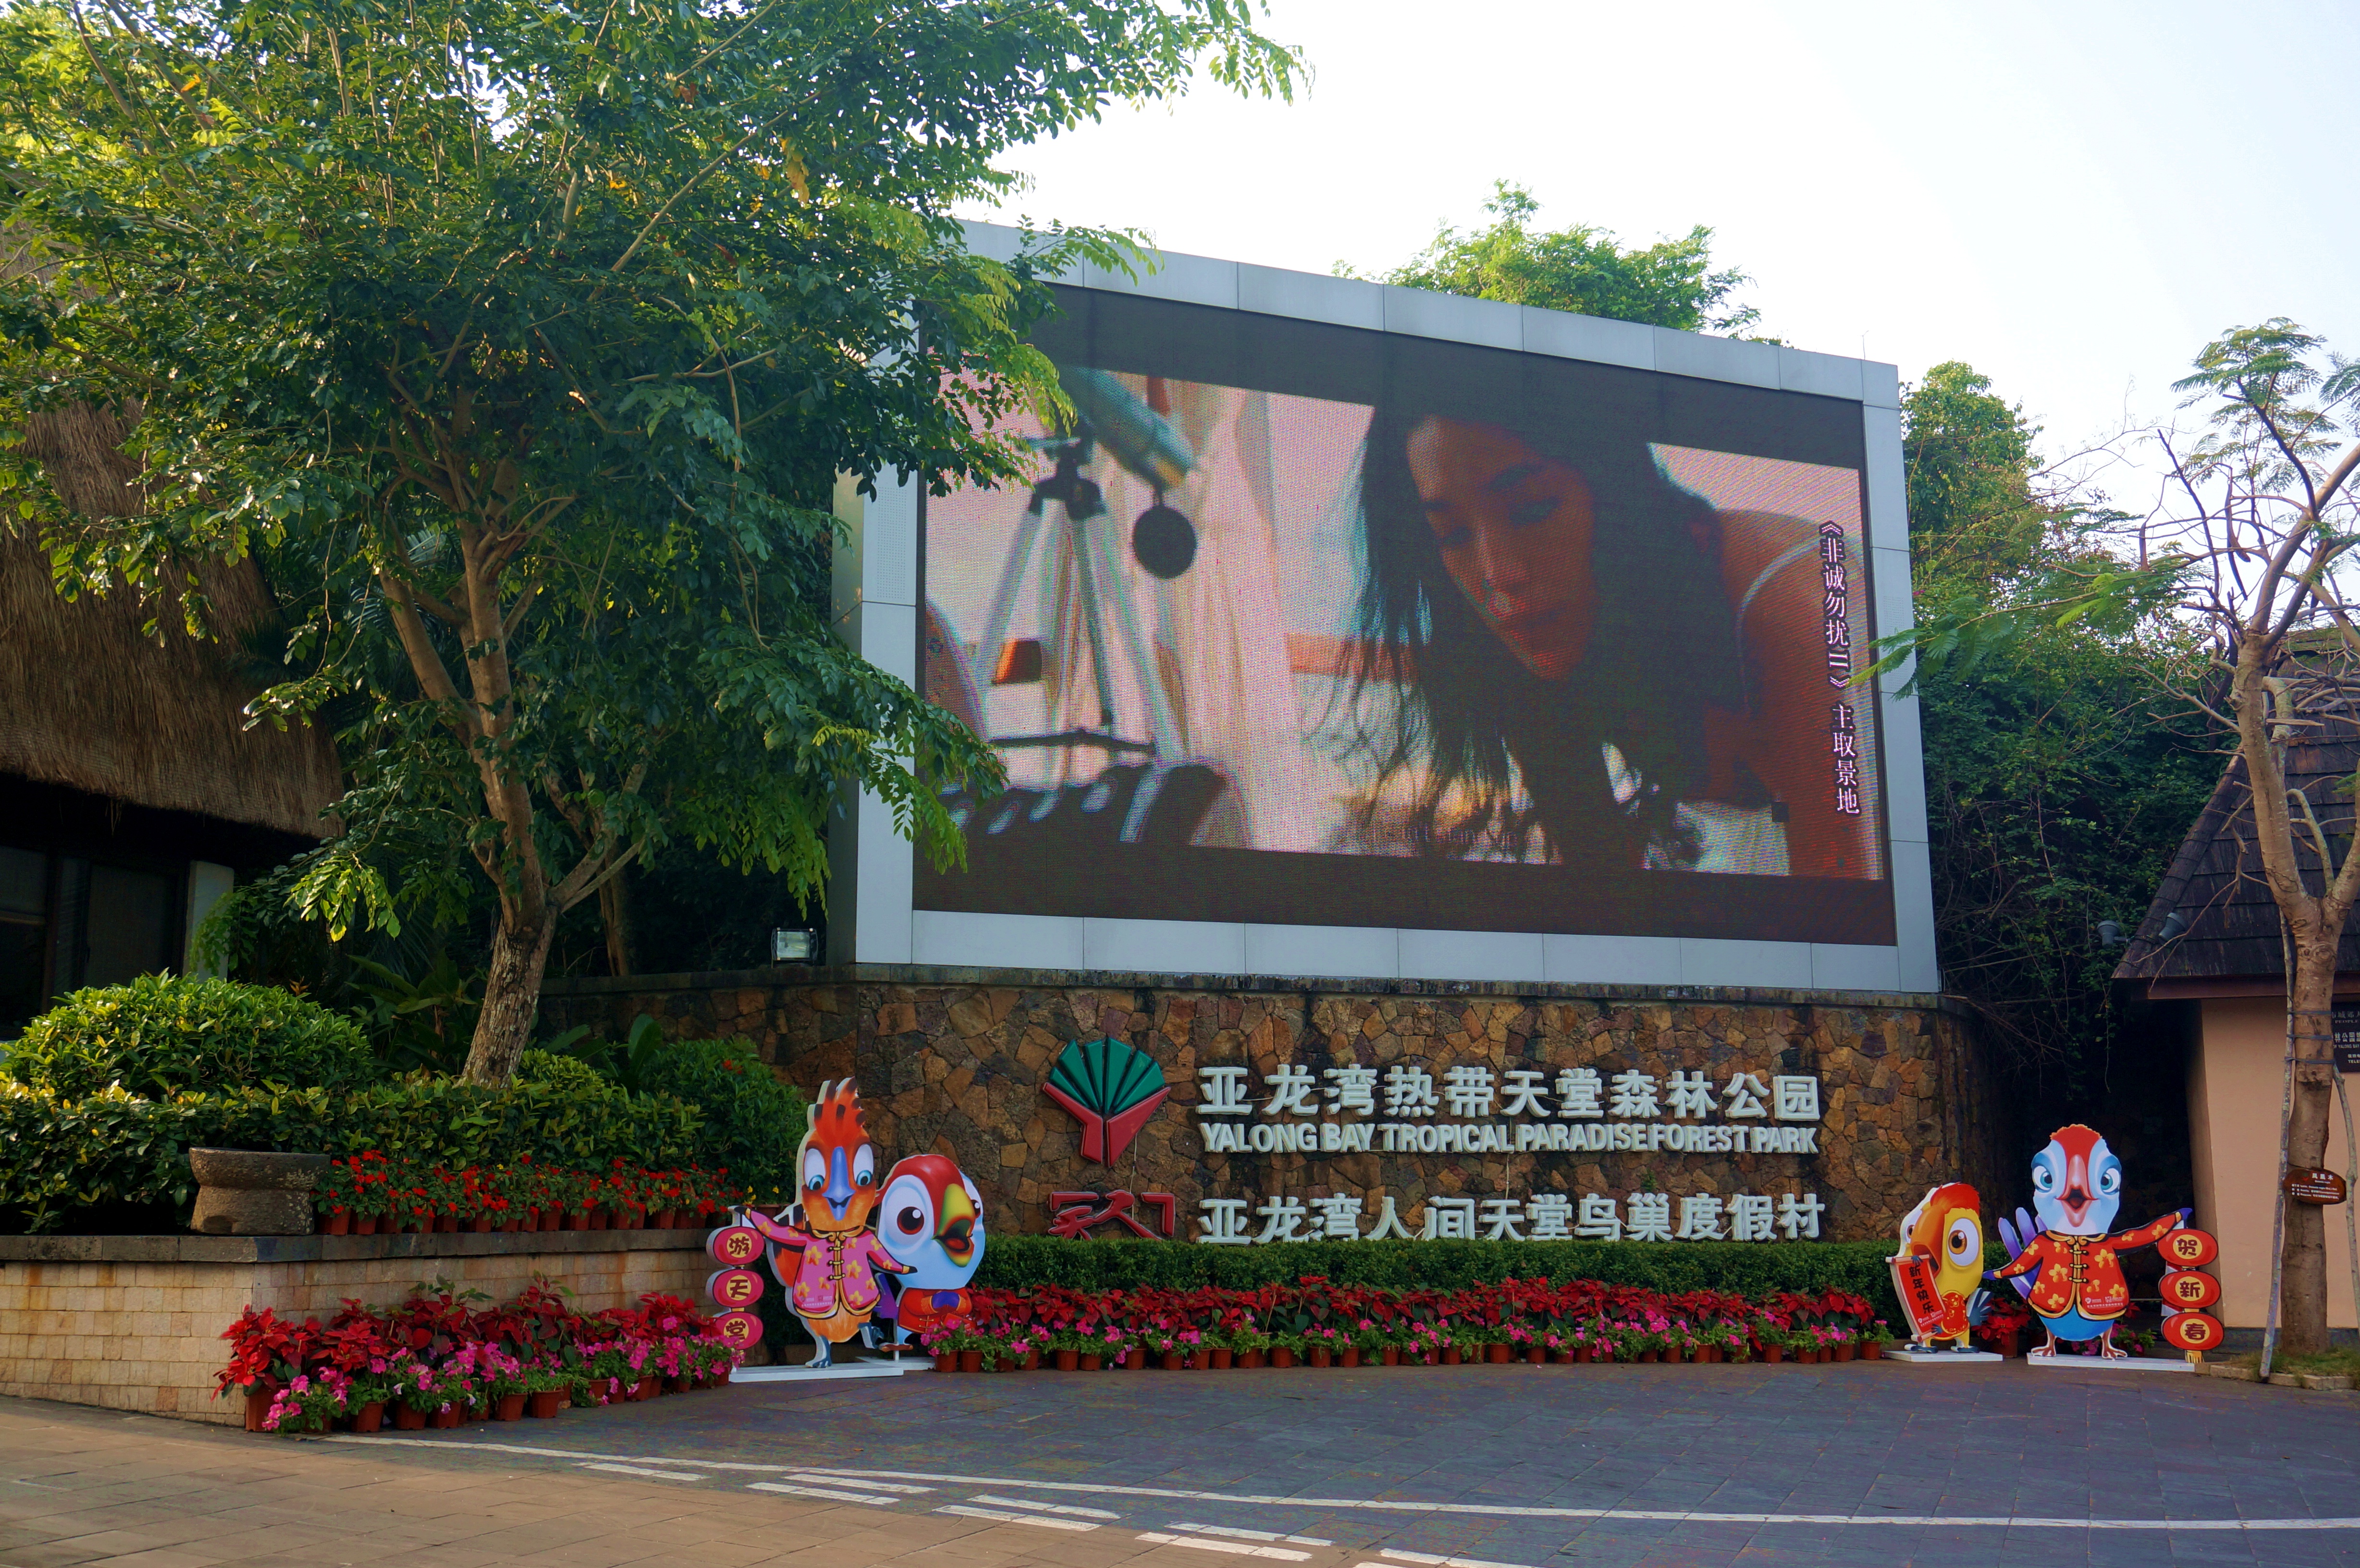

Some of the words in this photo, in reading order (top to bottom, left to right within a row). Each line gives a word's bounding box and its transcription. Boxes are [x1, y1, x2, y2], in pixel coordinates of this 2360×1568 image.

[1832, 704, 1860, 813] 主取景地
[1195, 1064, 1820, 1121] 亚龙湾热带天堂森林公园
[1201, 1123, 1317, 1152] YALONG
[1319, 1123, 1376, 1152] BAY
[1377, 1123, 1514, 1152] TROPICAL
[1515, 1123, 1647, 1152] PARADISE
[1647, 1124, 1749, 1152] FOREST
[1750, 1127, 1819, 1153] PARK
[1195, 1193, 1825, 1246] 亚龙湾人间天堂鸟巢度假村
[1908, 1264, 1934, 1314] 新年快乐
